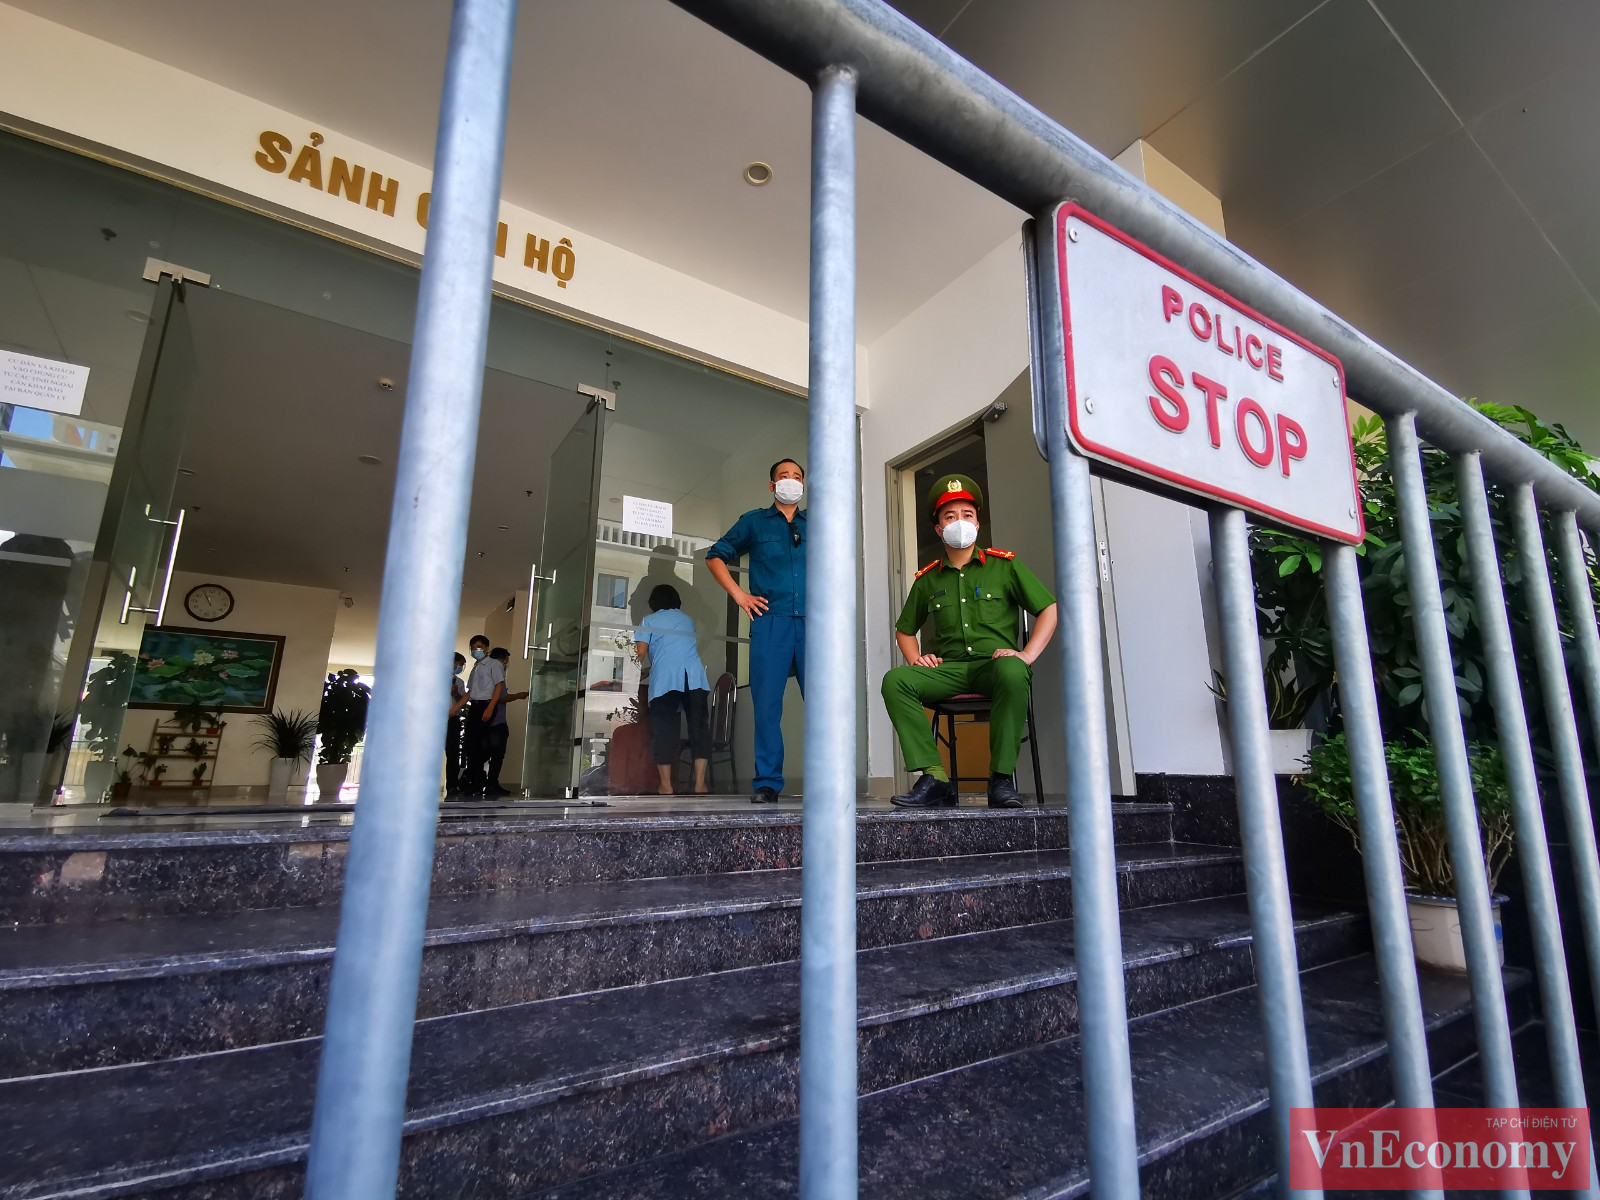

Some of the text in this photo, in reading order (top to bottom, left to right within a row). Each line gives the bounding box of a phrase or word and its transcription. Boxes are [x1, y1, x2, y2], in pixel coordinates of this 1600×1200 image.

[255, 130, 576, 289] SẢNH HỘ
[1161, 285, 1284, 383] POLICE
[1148, 354, 1308, 478] STOP
